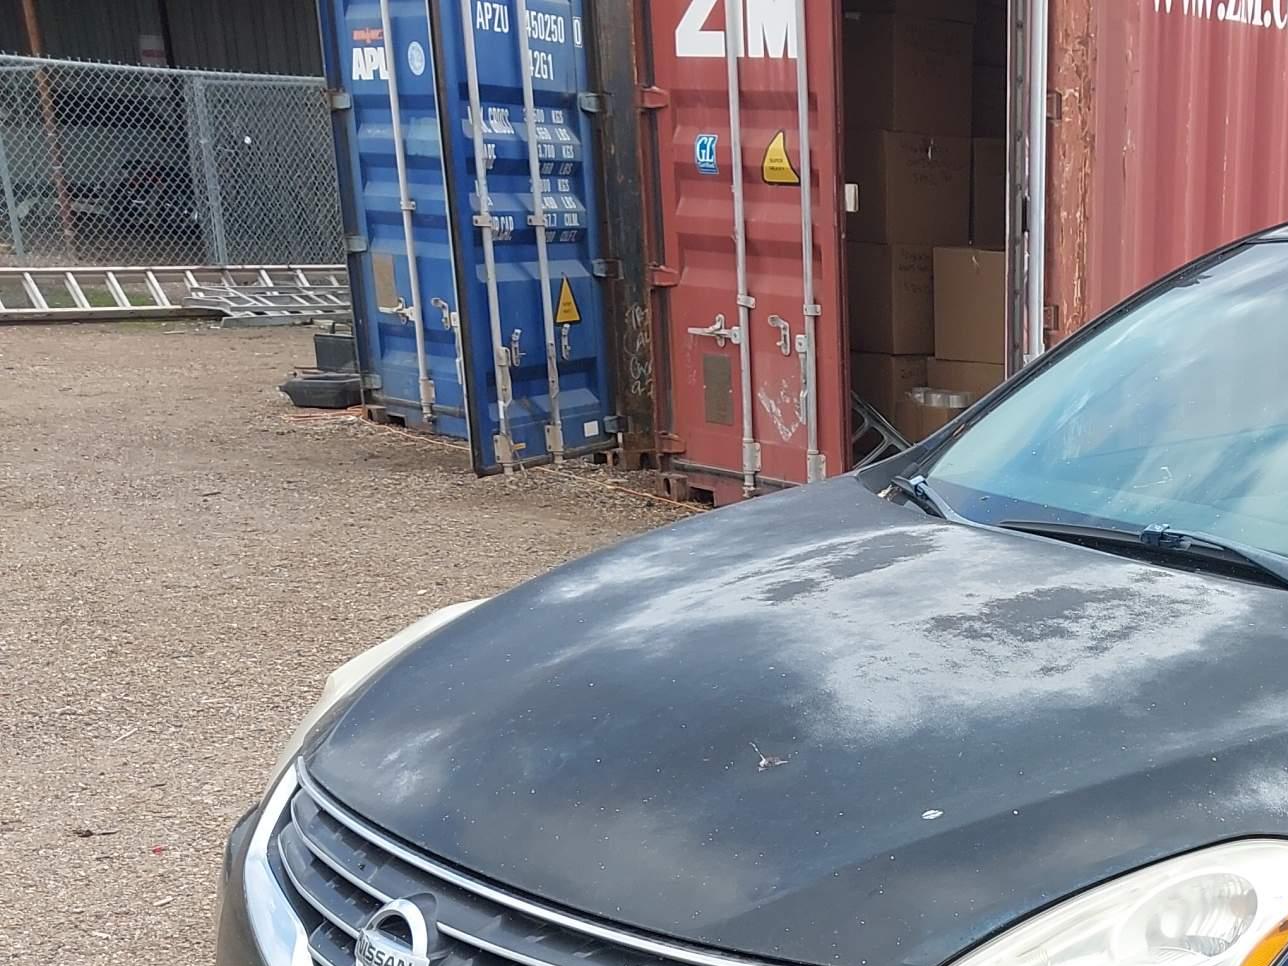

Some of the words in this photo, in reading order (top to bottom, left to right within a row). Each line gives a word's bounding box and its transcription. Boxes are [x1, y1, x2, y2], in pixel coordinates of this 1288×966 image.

[476, 1, 509, 33] APZU
[573, 16, 583, 49] 0
[352, 46, 391, 81] APL
